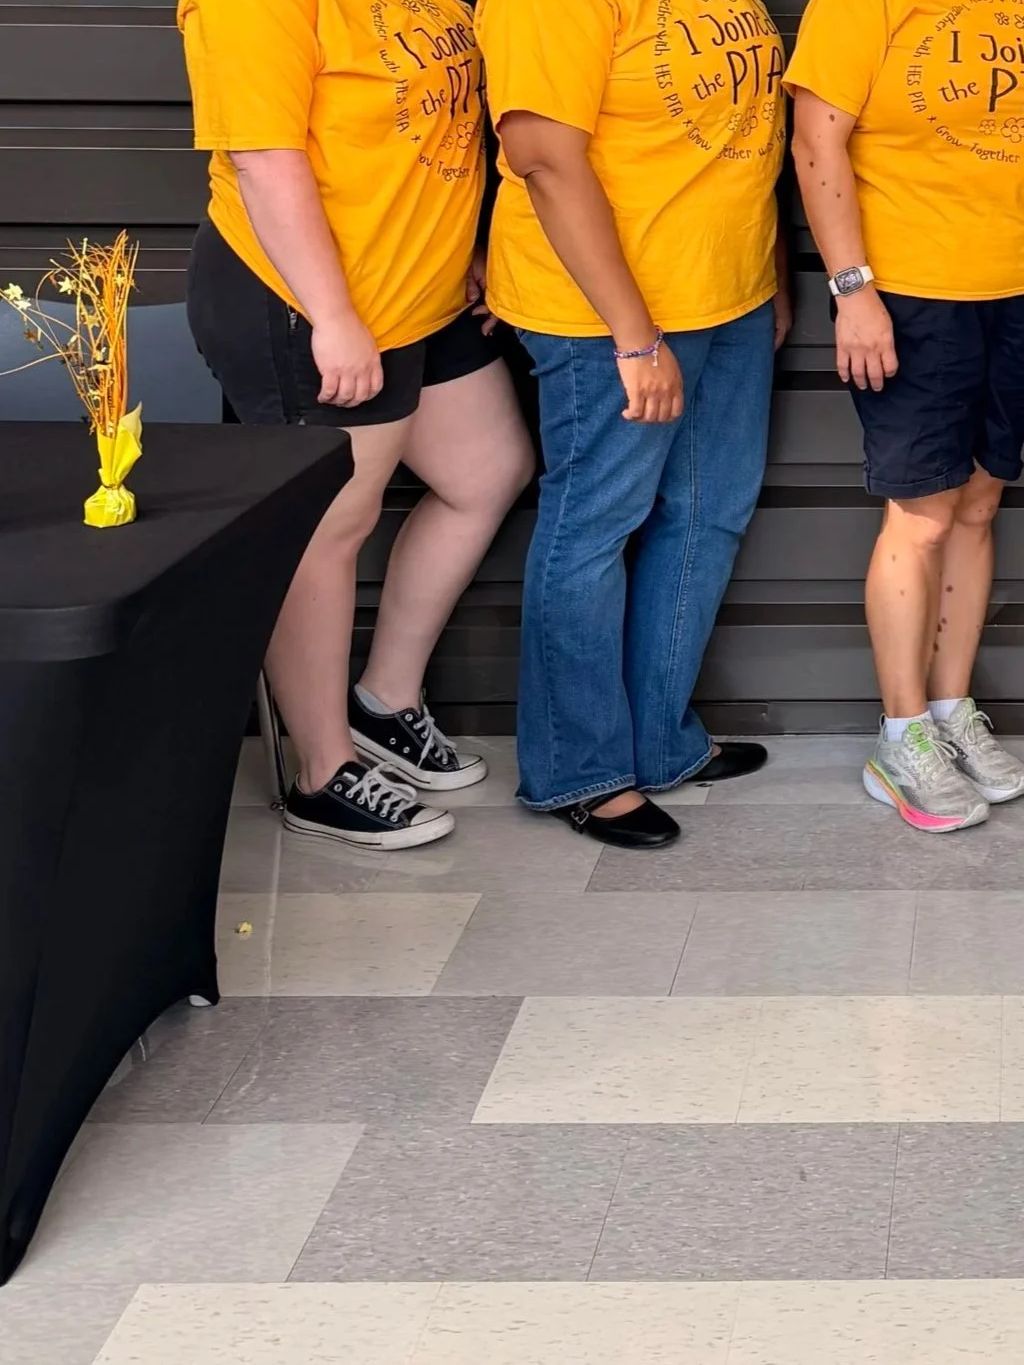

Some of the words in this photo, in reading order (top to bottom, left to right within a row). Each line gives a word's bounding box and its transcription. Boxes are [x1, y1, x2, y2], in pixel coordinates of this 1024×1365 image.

[674, 19, 702, 56] I
[913, 35, 935, 59] with
[948, 30, 963, 64] I
[393, 31, 428, 70] I
[654, 63, 673, 90] HES
[691, 72, 726, 101] the
[907, 65, 923, 86] HES
[907, 91, 928, 114] PTA
[938, 79, 981, 103] the
[662, 92, 684, 118] PTA
[395, 108, 410, 133] PTA
[687, 127, 713, 151] Grow
[935, 125, 963, 147] Grow
[969, 141, 1021, 163] Together
